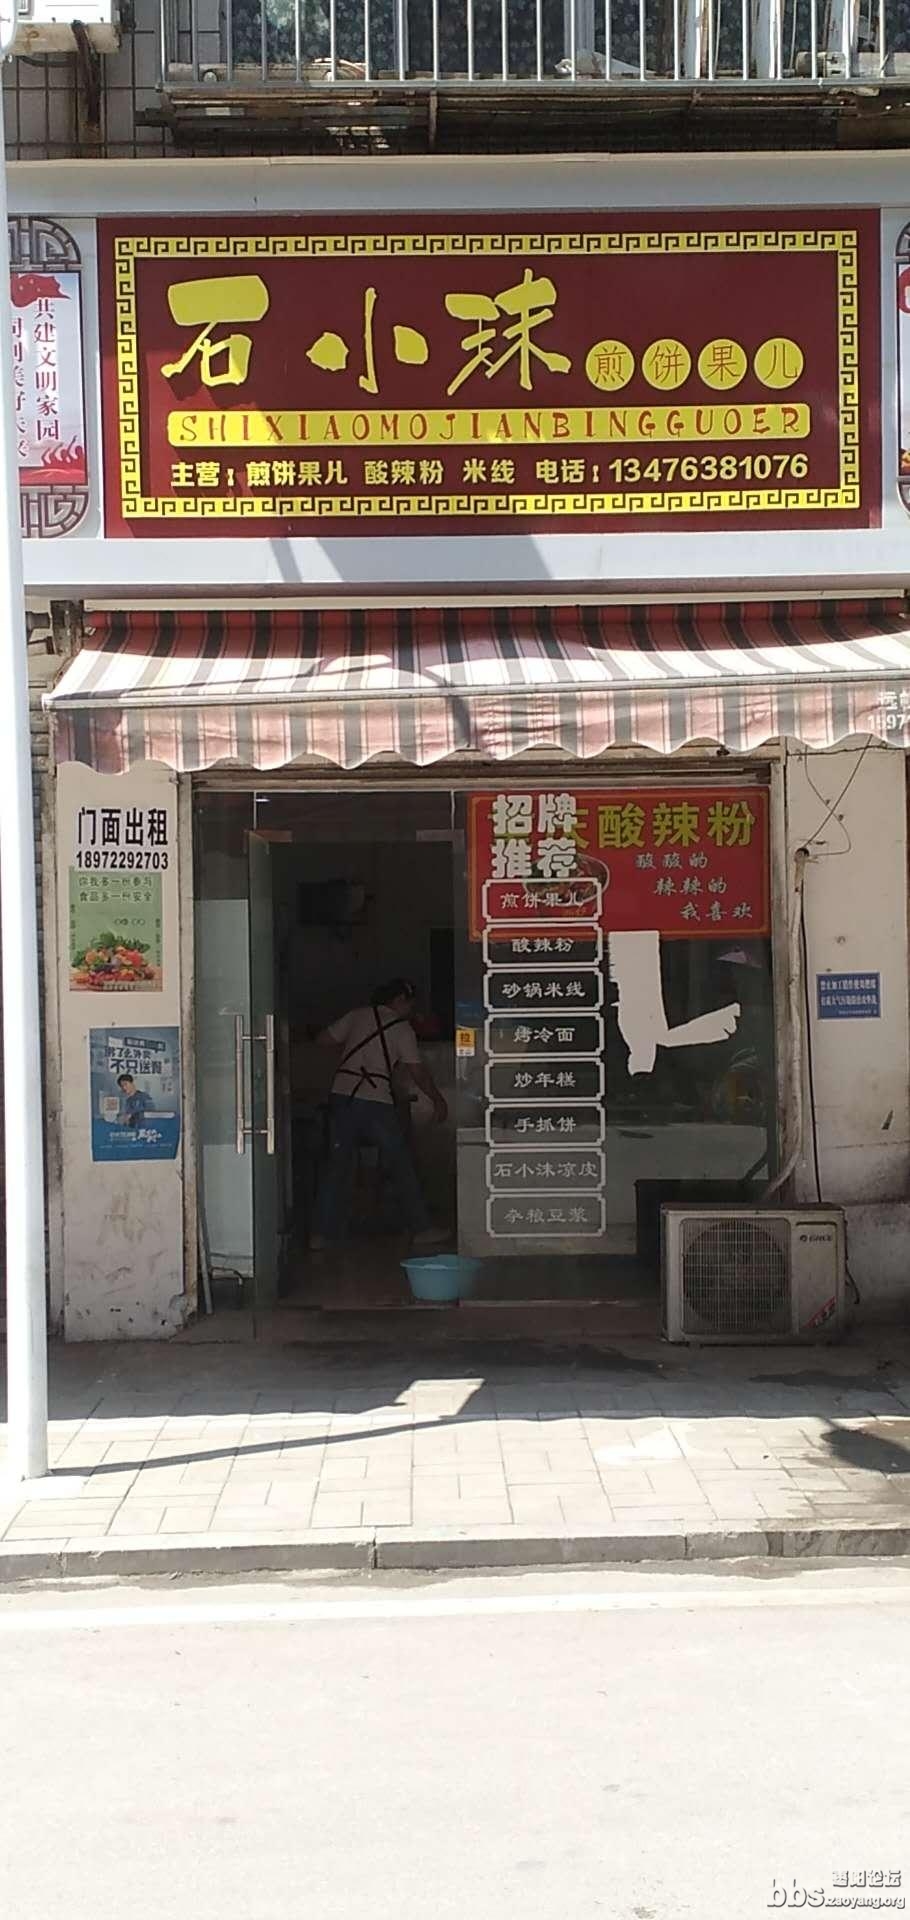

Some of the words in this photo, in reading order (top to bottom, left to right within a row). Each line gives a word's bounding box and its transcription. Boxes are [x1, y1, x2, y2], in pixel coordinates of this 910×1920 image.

[33, 297, 61, 442] 共建文明家园
[592, 342, 800, 385] 煎饼果儿
[179, 407, 802, 443] SHIXIAOMOJIANBINGGUOER
[364, 459, 445, 485] 酸辣粉
[462, 458, 516, 485] 米线
[491, 793, 579, 835] 招牌
[77, 806, 169, 847] 门面出租
[75, 851, 169, 870] 18972292703
[490, 837, 579, 879] 推荐
[635, 850, 709, 870] 酸酸的
[653, 875, 728, 897] 辣辣的
[500, 890, 584, 909] 煎饼果儿
[680, 900, 753, 922] 我喜欢
[511, 937, 575, 953] 酸辣粉
[501, 980, 586, 999] 砂锅米线
[513, 1026, 576, 1043] 烤冷面
[513, 1071, 577, 1089] 炒年糕
[513, 1116, 577, 1134] 手抓饼
[503, 1206, 589, 1224] 杂粮豆浆
